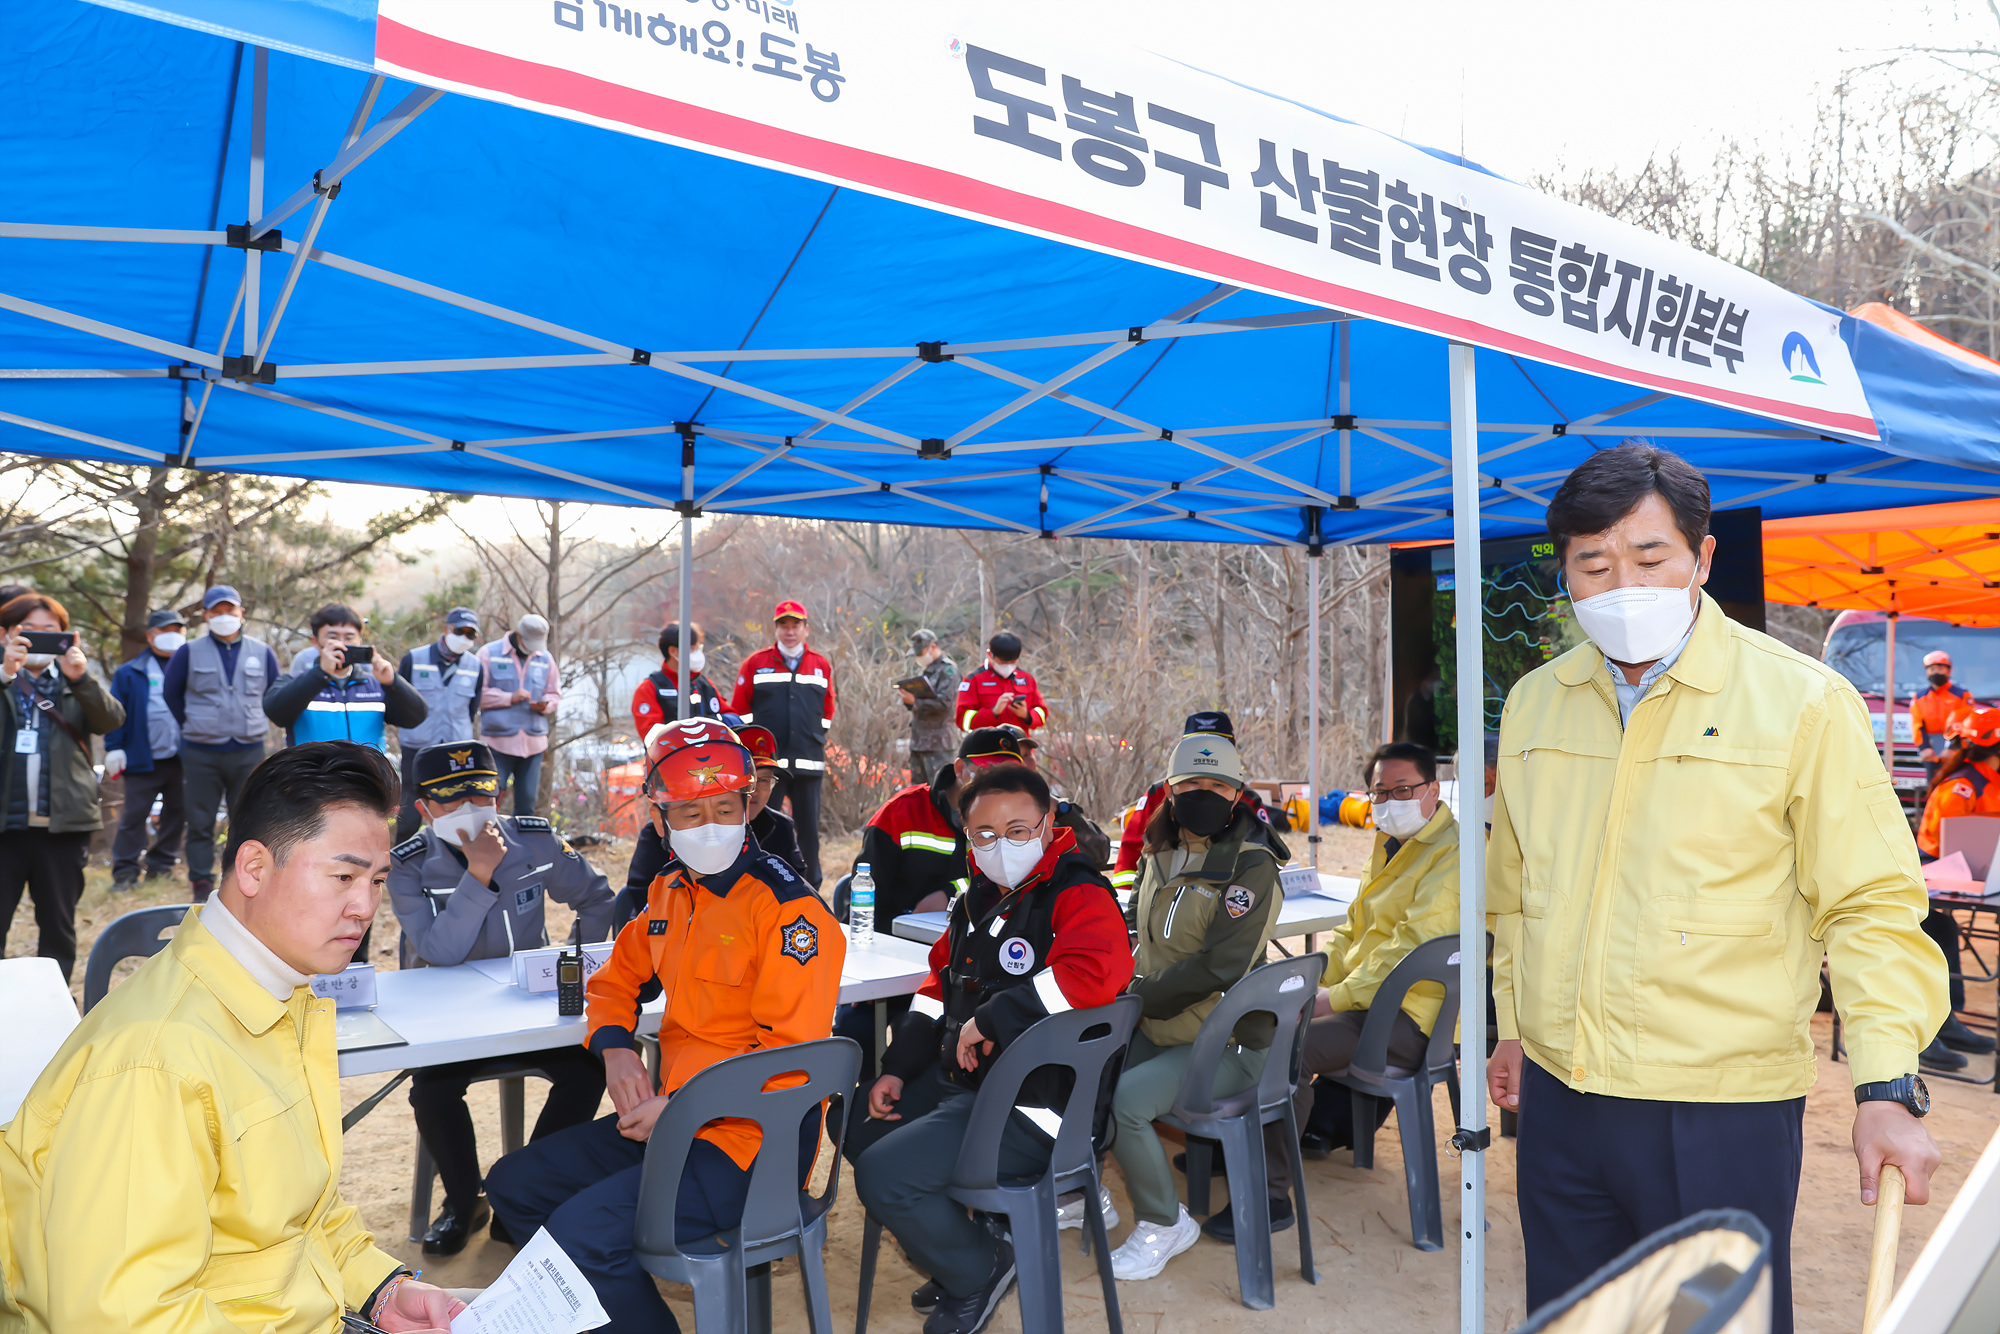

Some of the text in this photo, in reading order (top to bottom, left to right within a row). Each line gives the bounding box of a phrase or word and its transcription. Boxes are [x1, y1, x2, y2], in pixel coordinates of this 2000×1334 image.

[752, 32, 846, 102] 도봉
[966, 43, 1749, 374] 도봉구 산불현장 통합지휘본부
[314, 975, 358, 992] 괄반장
[1007, 961, 1025, 970] 산림청
